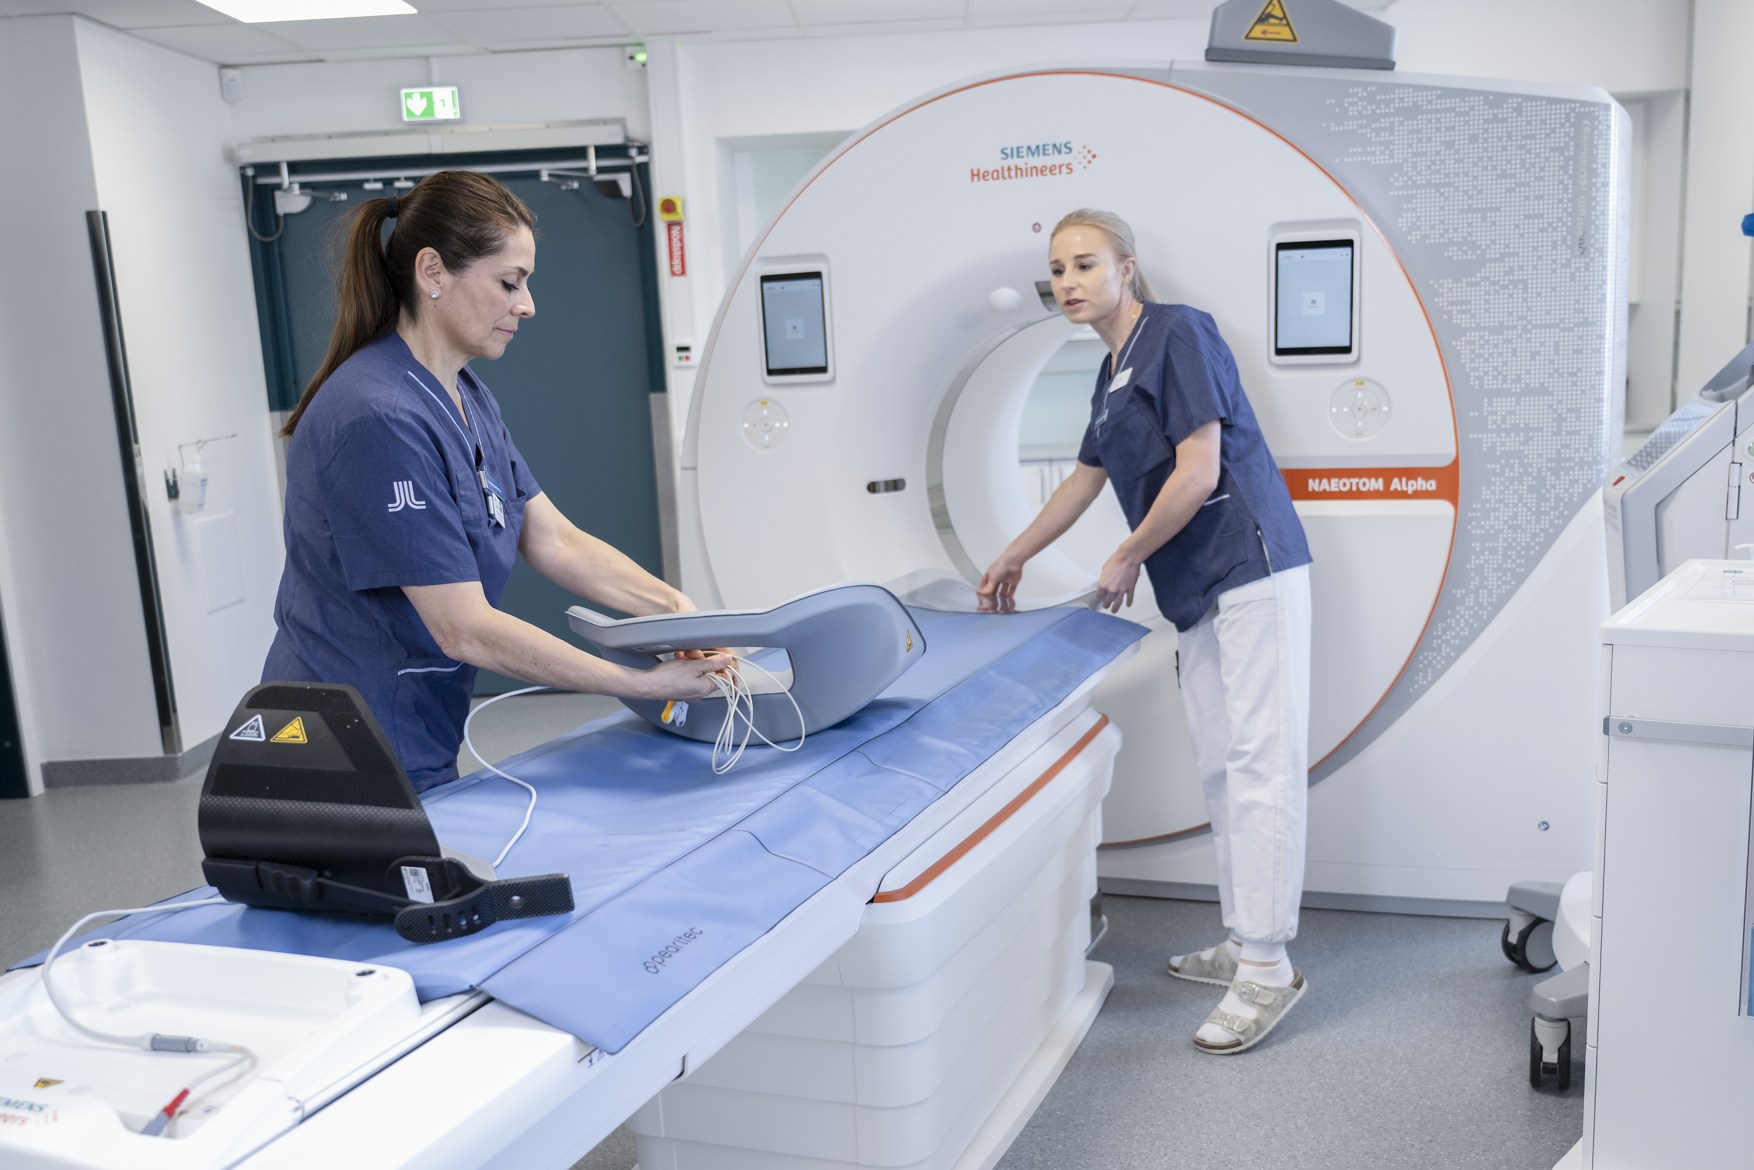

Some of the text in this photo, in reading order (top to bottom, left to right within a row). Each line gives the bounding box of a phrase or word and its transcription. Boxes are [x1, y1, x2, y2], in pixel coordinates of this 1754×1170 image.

[1000, 141, 1073, 160] SIEMENS
[970, 162, 1074, 182] Healthineers
[671, 225, 683, 275] Nödstopp
[1308, 476, 1437, 494] NAEOTOM Alpha
[651, 927, 703, 967] pearltec
